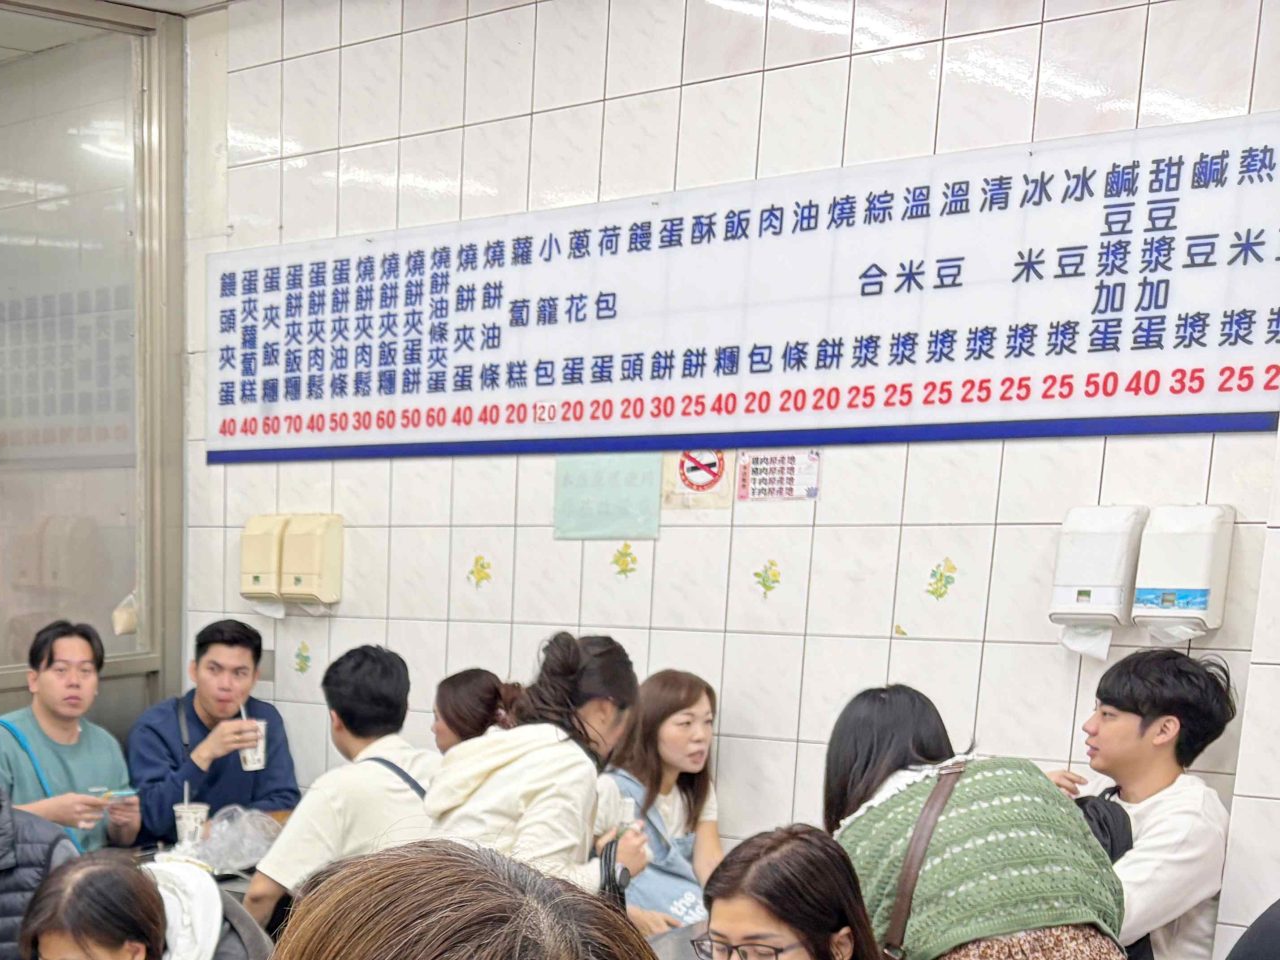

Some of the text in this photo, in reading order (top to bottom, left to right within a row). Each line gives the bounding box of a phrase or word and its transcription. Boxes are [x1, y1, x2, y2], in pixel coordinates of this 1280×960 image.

[1084, 160, 1140, 398] 鹹豆漿加蛋 50
[1124, 155, 1185, 396] 甜豆漿加蛋 40
[352, 255, 375, 431] 燒餅夾肉鬆 30
[376, 252, 400, 429] 燒餅夾飯糰 60
[401, 249, 425, 428] 燒餅夾蛋餅 50
[426, 246, 451, 427] 燒餅油條夾蛋 60
[452, 243, 478, 426] 燒餅夾蛋 40
[478, 240, 505, 424] 燒餅油條 40
[306, 261, 327, 433] 蛋餅夾肉鬆 40
[329, 258, 351, 432] 蛋餅夾油條 50
[961, 378, 992, 403] 25
[999, 376, 1031, 402] 25
[1041, 373, 1074, 400] 25
[1169, 367, 1205, 394] 35
[1218, 365, 1254, 392] 25
[710, 392, 737, 415] 40
[744, 391, 771, 414] 20
[779, 388, 807, 412] 20
[812, 387, 841, 410] 20
[847, 385, 876, 409] 25
[883, 383, 913, 407] 25
[922, 380, 953, 405] 25
[505, 403, 528, 423] 20
[561, 400, 584, 421] 20
[590, 399, 613, 420] 20
[620, 397, 644, 419] 20
[650, 396, 675, 418] 30
[681, 394, 706, 417] 25
[219, 418, 237, 436] 40
[240, 417, 258, 436] 40
[262, 416, 280, 435] 60
[284, 415, 302, 434] 70
